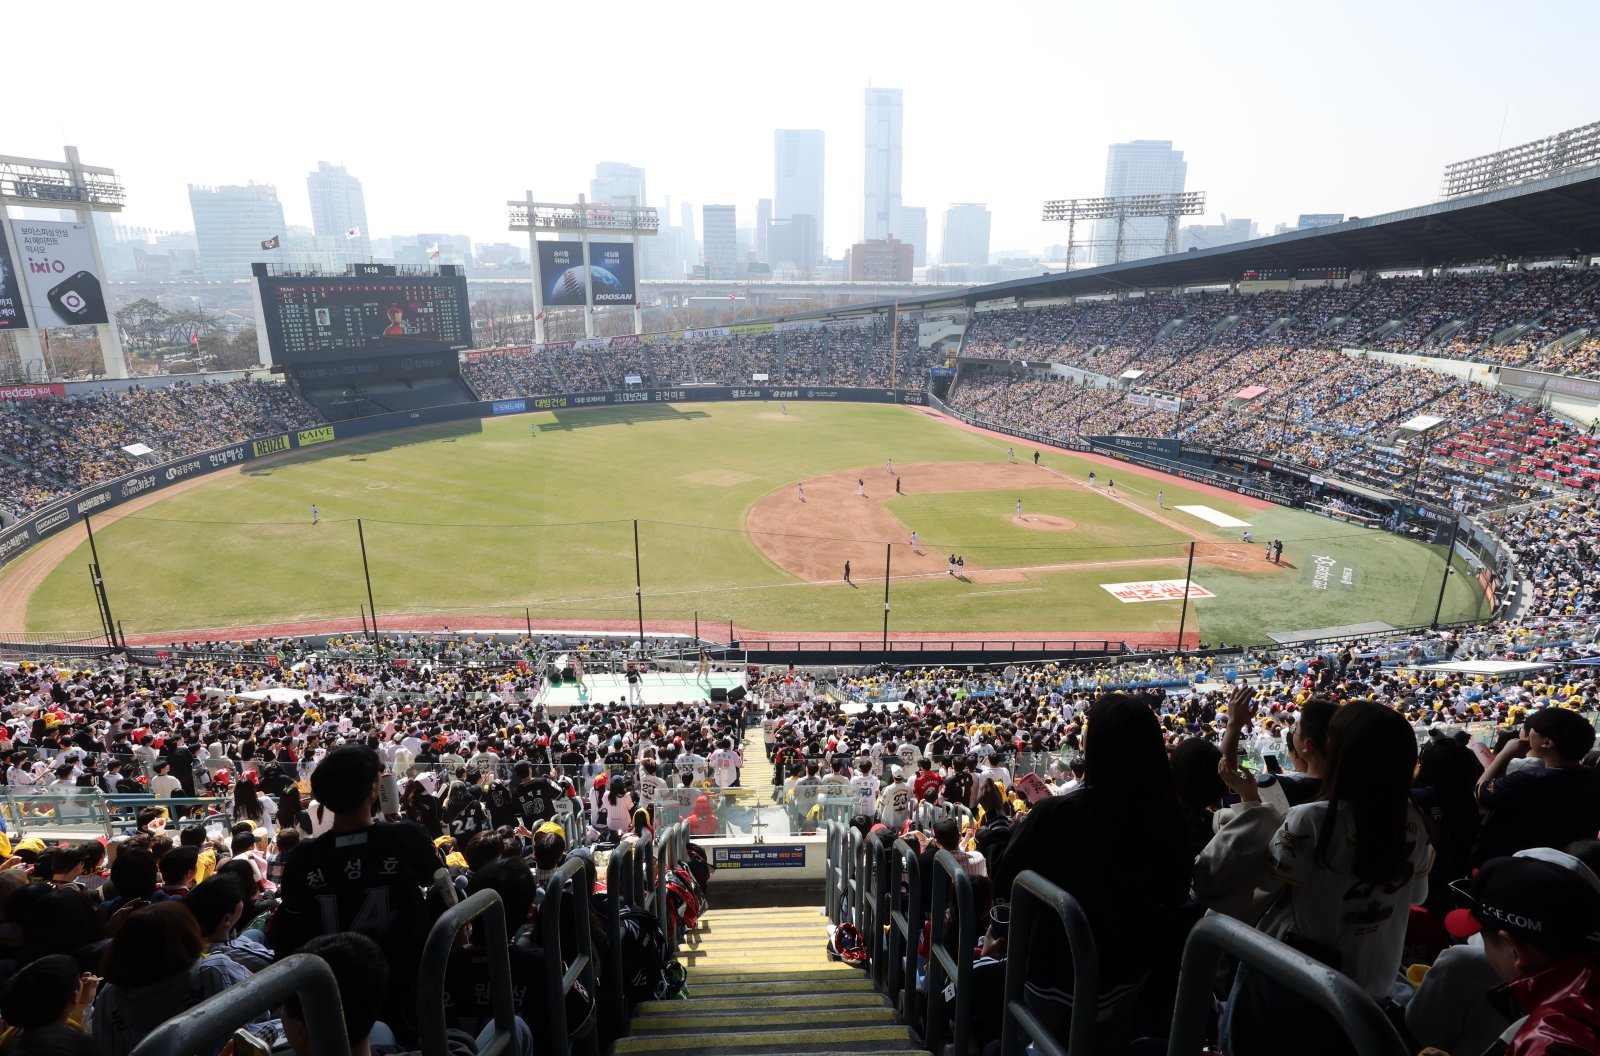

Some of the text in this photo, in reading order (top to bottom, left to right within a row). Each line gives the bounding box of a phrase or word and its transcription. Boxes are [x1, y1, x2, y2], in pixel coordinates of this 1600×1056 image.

[1, 387, 36, 398] redcap
[623, 392, 648, 401] 대보건설
[655, 391, 686, 400] 금천미트
[535, 397, 567, 408] 대방건설
[299, 428, 333, 440] KAIVE
[209, 448, 244, 467] 현대해상
[177, 461, 200, 476] 금강주택
[1426, 511, 1436, 519] IBK
[784, 756, 793, 764] 71
[682, 764, 694, 772] 53
[452, 817, 477, 835] 24
[306, 857, 399, 889] 천성호
[315, 886, 397, 934] 14
